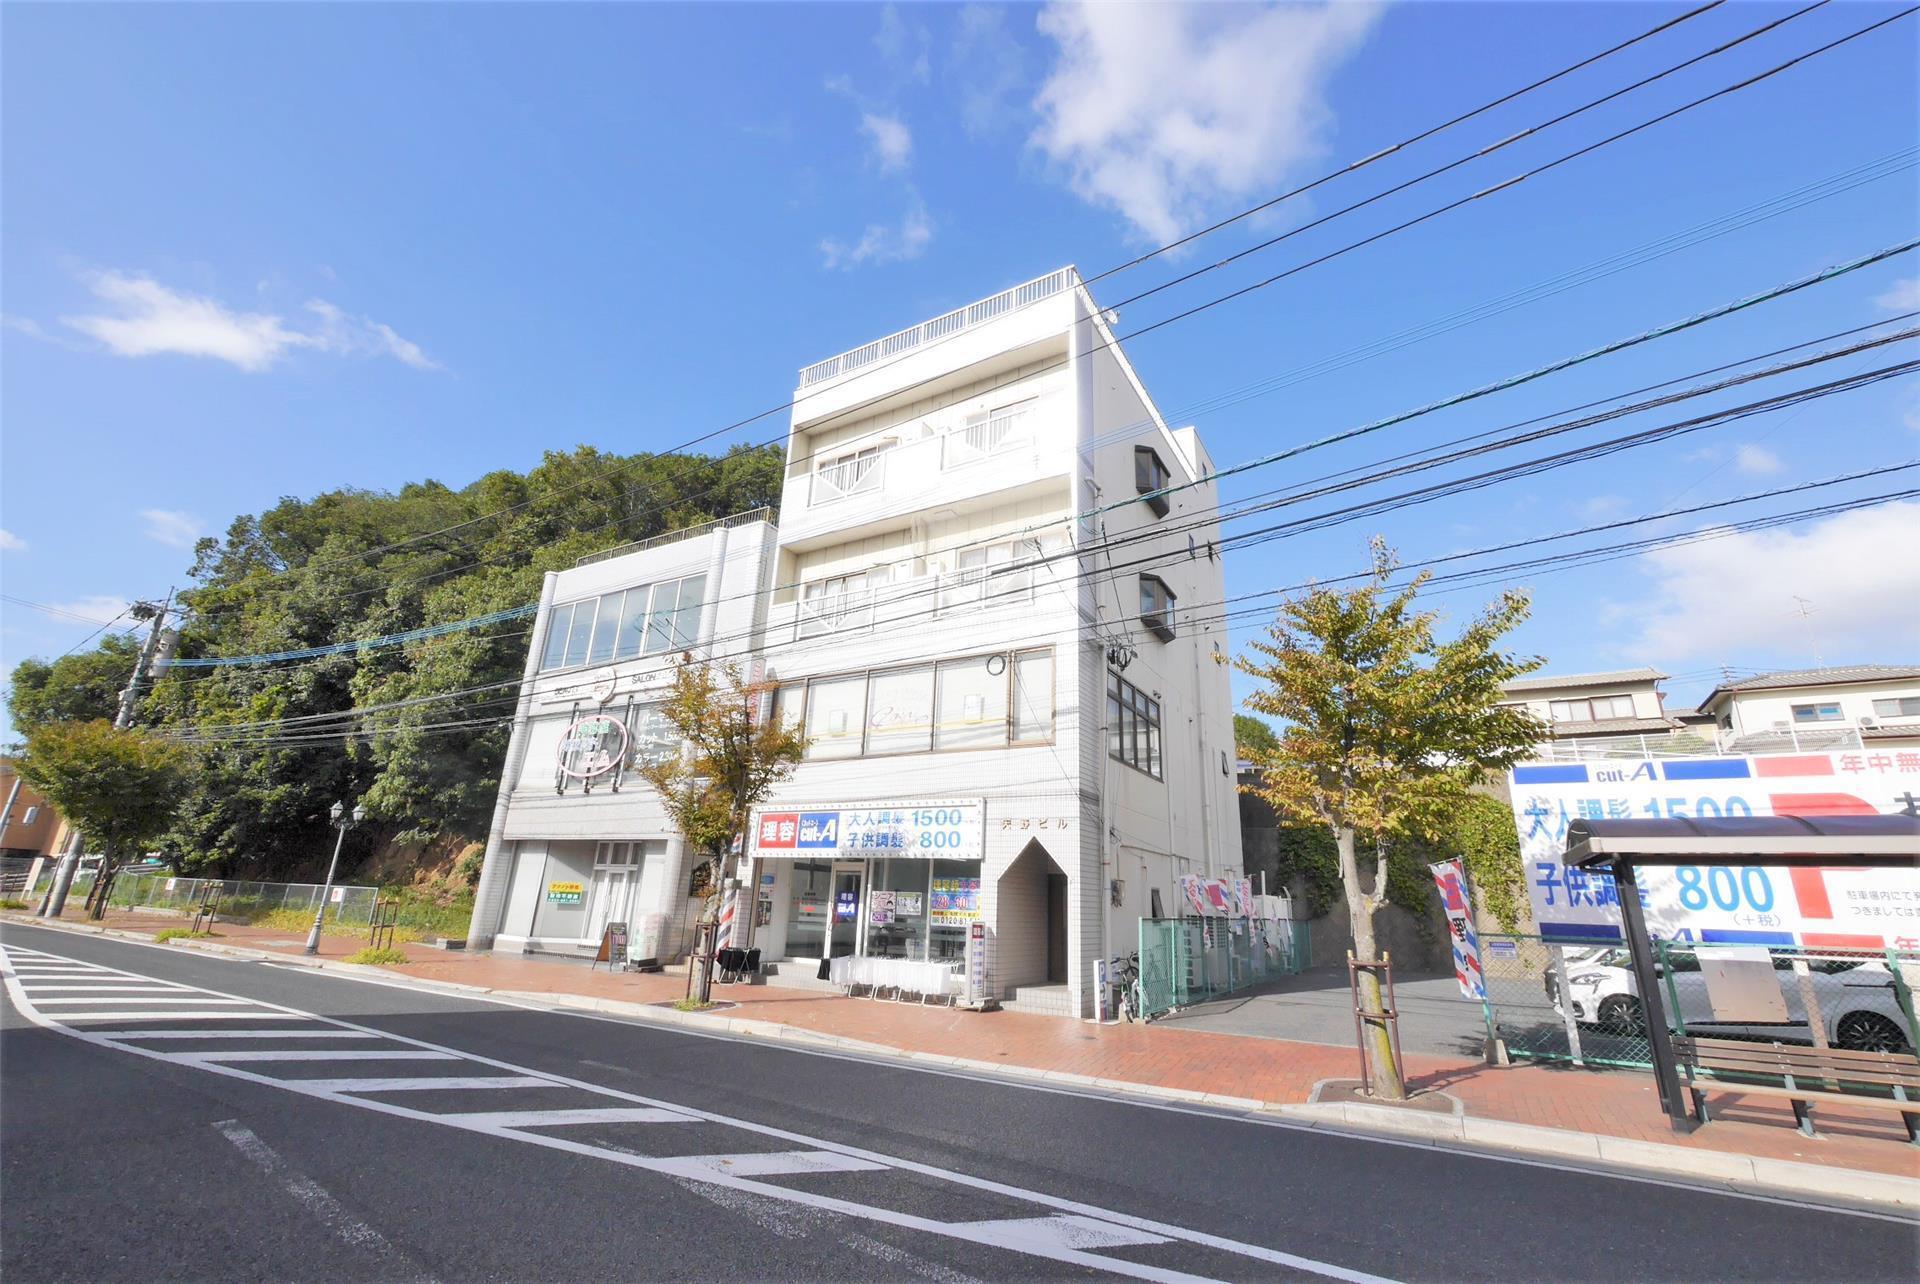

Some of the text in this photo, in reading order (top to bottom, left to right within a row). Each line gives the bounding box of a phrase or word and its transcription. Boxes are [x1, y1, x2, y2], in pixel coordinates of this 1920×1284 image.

[631, 674, 657, 685] SALON
[848, 809, 962, 827] 大人調髪 1500
[762, 820, 795, 841] 理容
[847, 831, 961, 849] 子供調髪 800
[1675, 866, 1774, 913] 800
